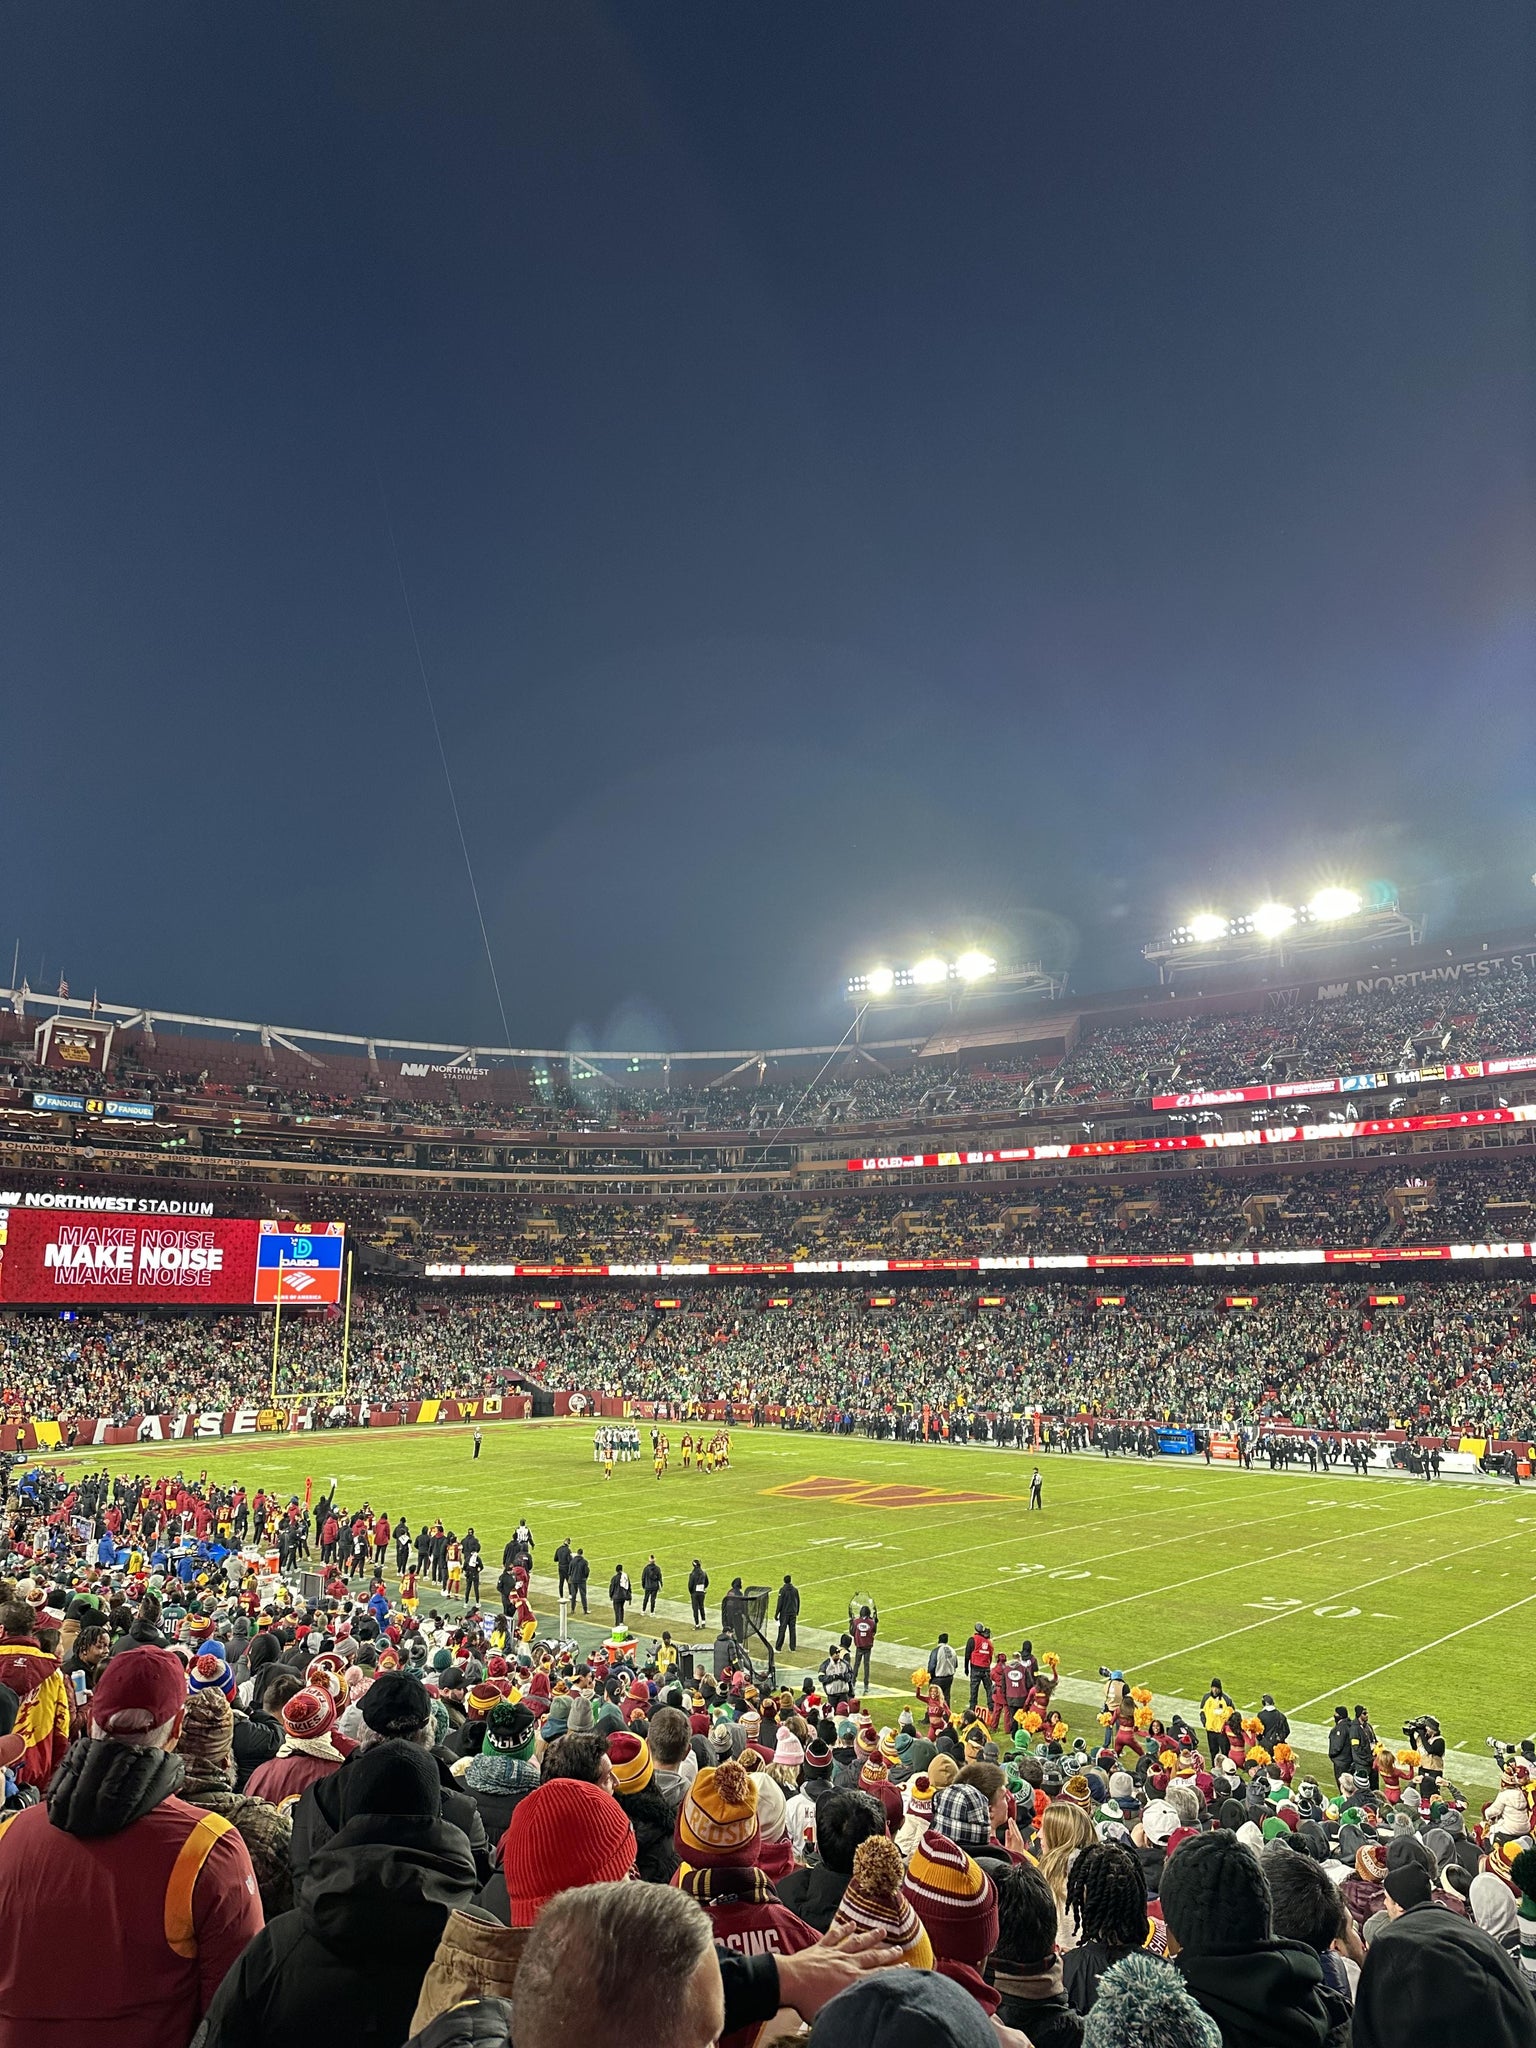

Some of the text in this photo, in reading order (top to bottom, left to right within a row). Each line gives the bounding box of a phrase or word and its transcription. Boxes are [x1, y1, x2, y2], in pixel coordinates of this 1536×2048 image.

[1356, 957, 1505, 995] NORTHWEST
[400, 1063, 490, 1077] NW NORTHWEST
[443, 1073, 478, 1081] STADIUM
[47, 1098, 83, 1109] FANDUEL
[118, 1105, 153, 1115] FANDUEL
[1266, 1127, 1297, 1144] UP
[6, 1142, 78, 1154] CHAMPIONS
[134, 1152, 160, 1160] 1942
[863, 1158, 876, 1169] LG
[878, 1157, 903, 1169] OLED
[25, 1193, 136, 1212] NORTHWEST
[138, 1199, 214, 1215] STADIUM
[58, 1226, 215, 1249] MAKE NOISE
[44, 1243, 224, 1270] MAKE NOISE
[55, 1265, 212, 1286] MAKE NOISE
[997, 1562, 1092, 1581] 30
[1242, 1596, 1362, 1619] 20
[164, 1618, 178, 1634] 90
[805, 1807, 817, 1819] Mc
